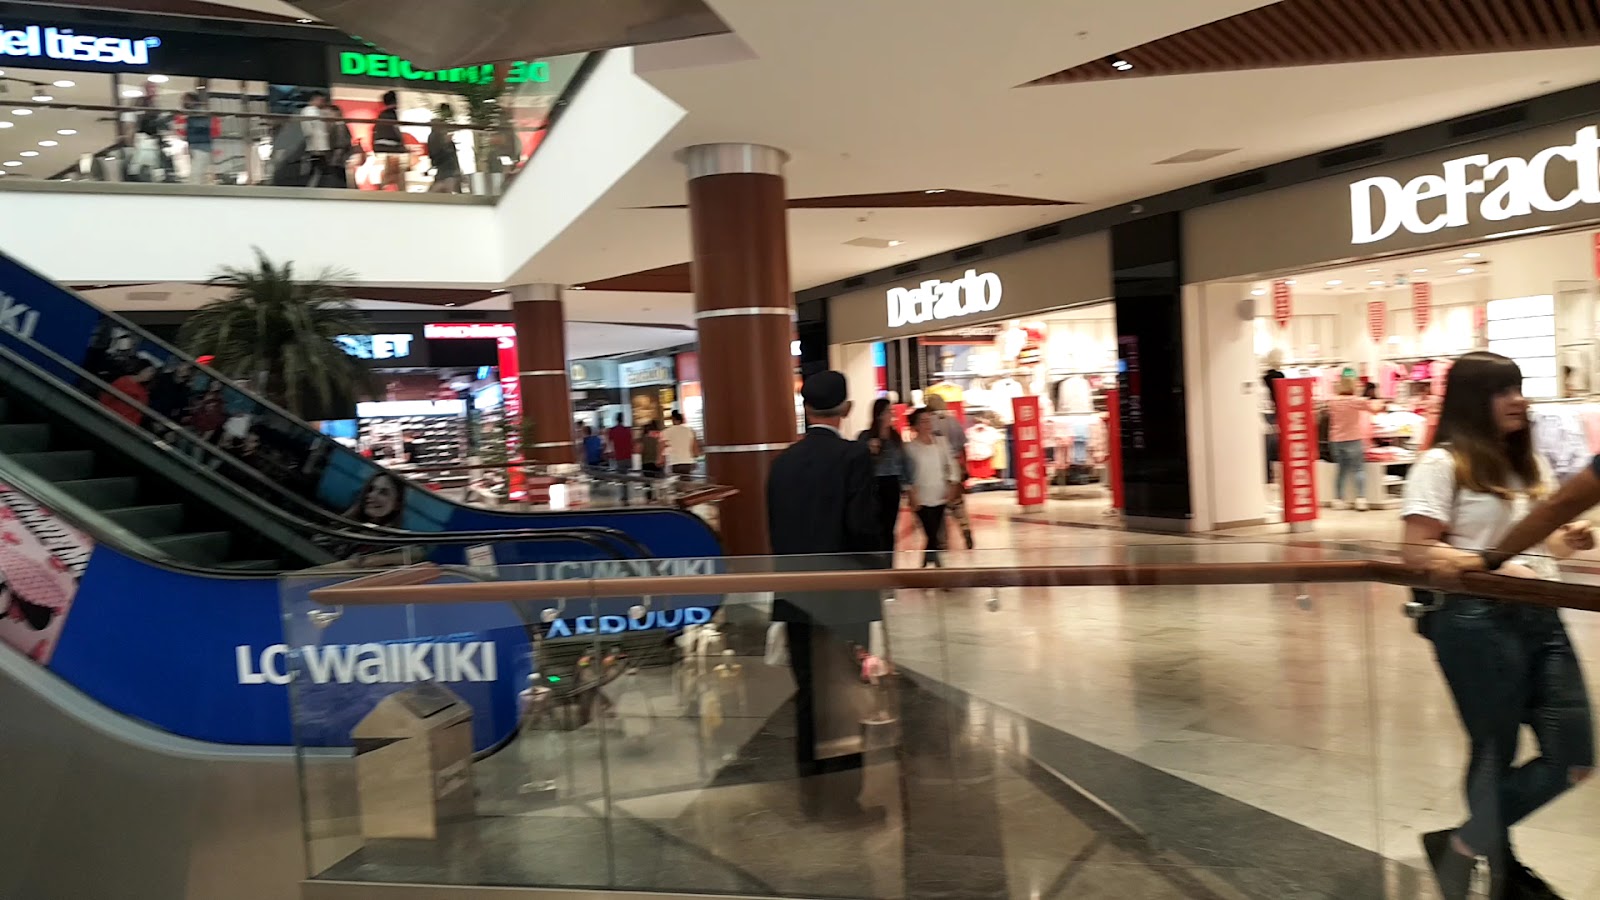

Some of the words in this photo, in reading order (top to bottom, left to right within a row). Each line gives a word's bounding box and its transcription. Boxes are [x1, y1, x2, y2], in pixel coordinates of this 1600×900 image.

[44, 27, 149, 64] tissu
[1349, 125, 1600, 244] DeFact
[886, 269, 1002, 328] DeFacto
[235, 643, 299, 685] LC
